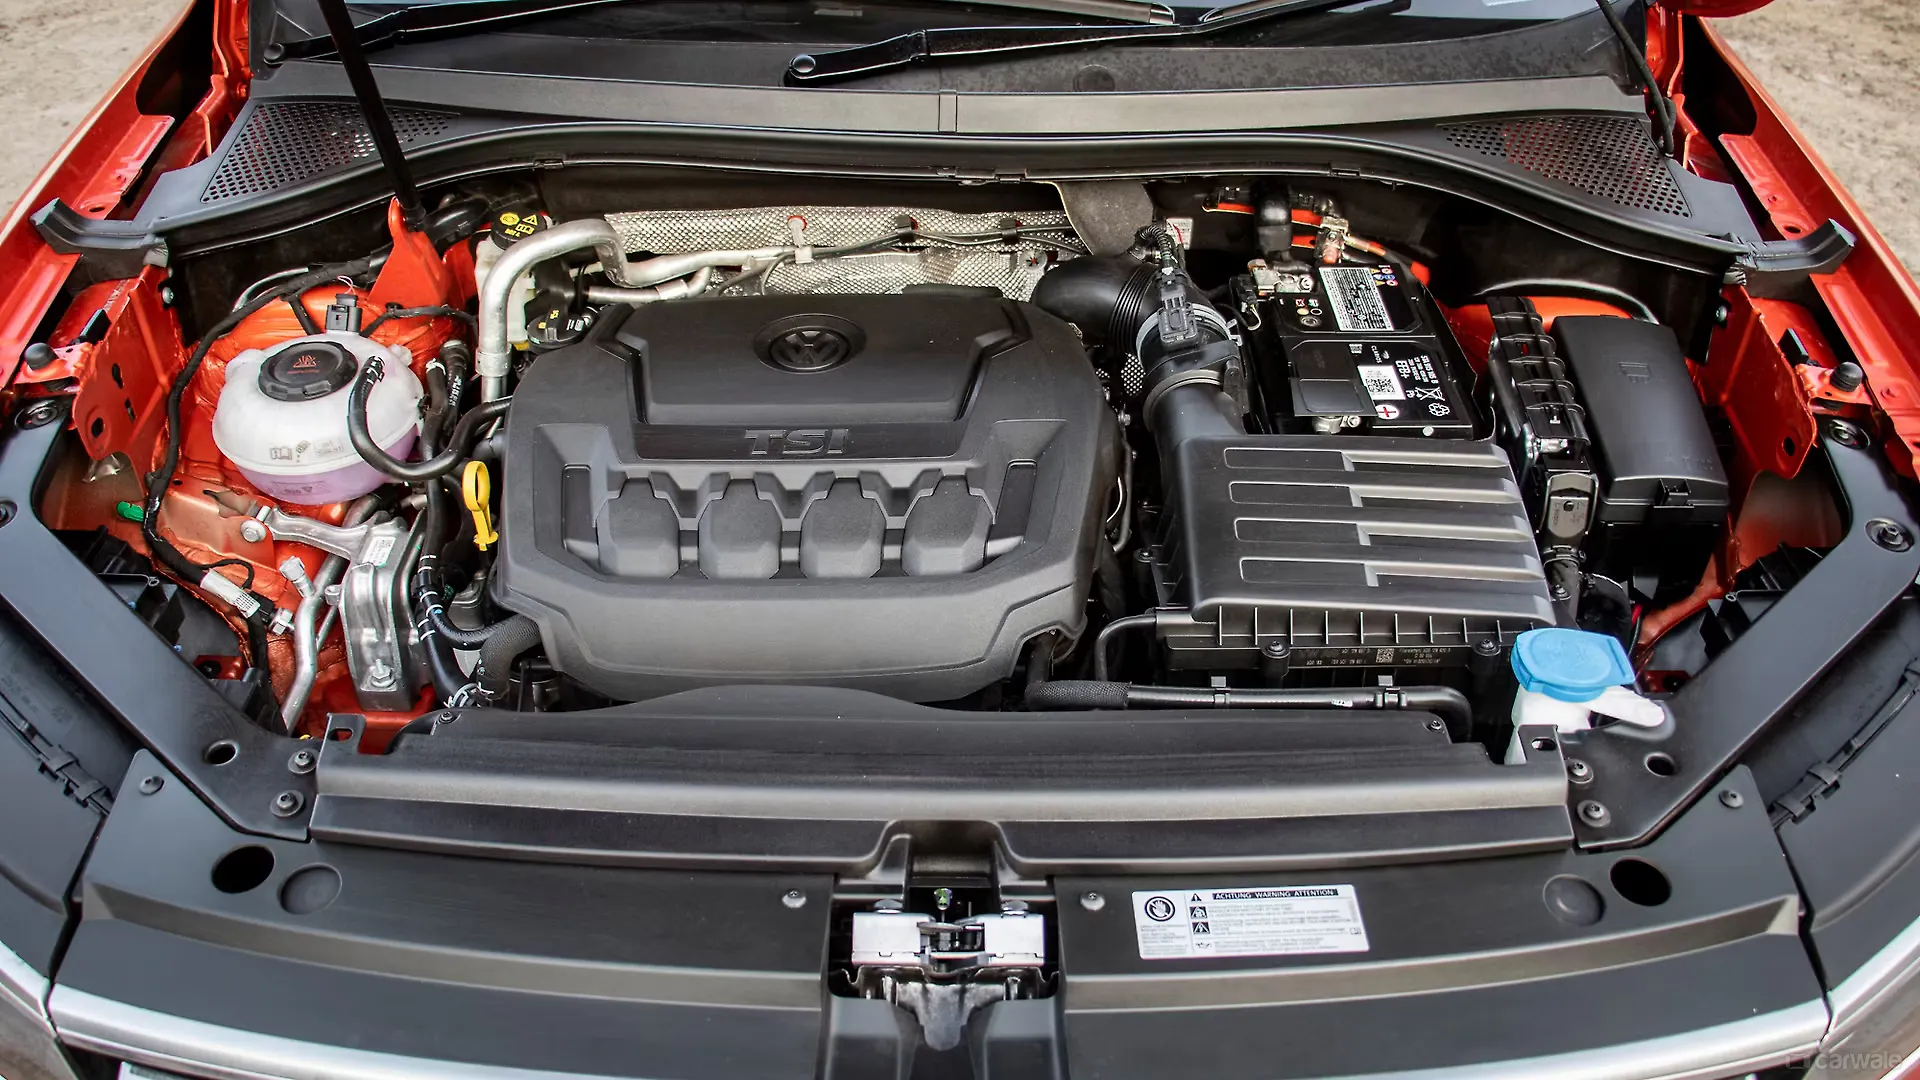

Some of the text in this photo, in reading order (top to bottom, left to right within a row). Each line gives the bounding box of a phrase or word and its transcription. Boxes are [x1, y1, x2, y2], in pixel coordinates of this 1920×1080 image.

[1395, 360, 1411, 378] EFB+
[744, 429, 849, 455] TSI
[1215, 889, 1335, 901] ACHTUNG WARNING ATTENTION
